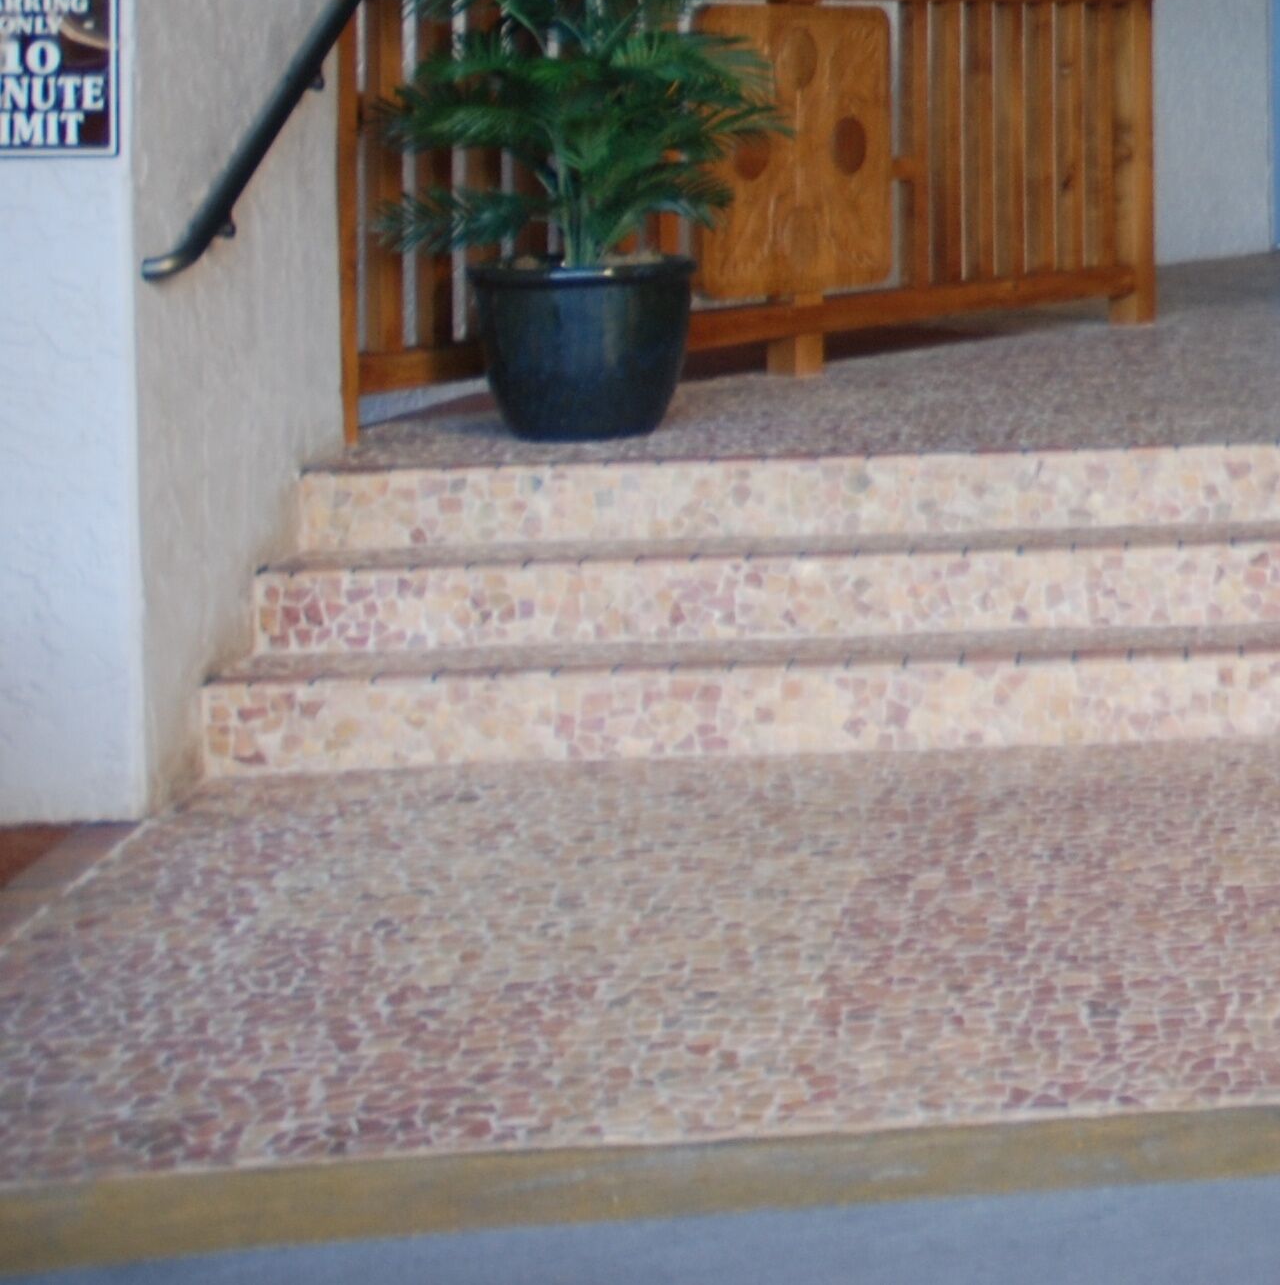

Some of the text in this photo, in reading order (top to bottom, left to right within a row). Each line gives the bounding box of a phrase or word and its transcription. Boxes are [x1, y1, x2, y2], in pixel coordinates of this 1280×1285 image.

[0, 15, 62, 35] ONLY
[0, 39, 61, 75] 10
[0, 76, 104, 111] NUTE
